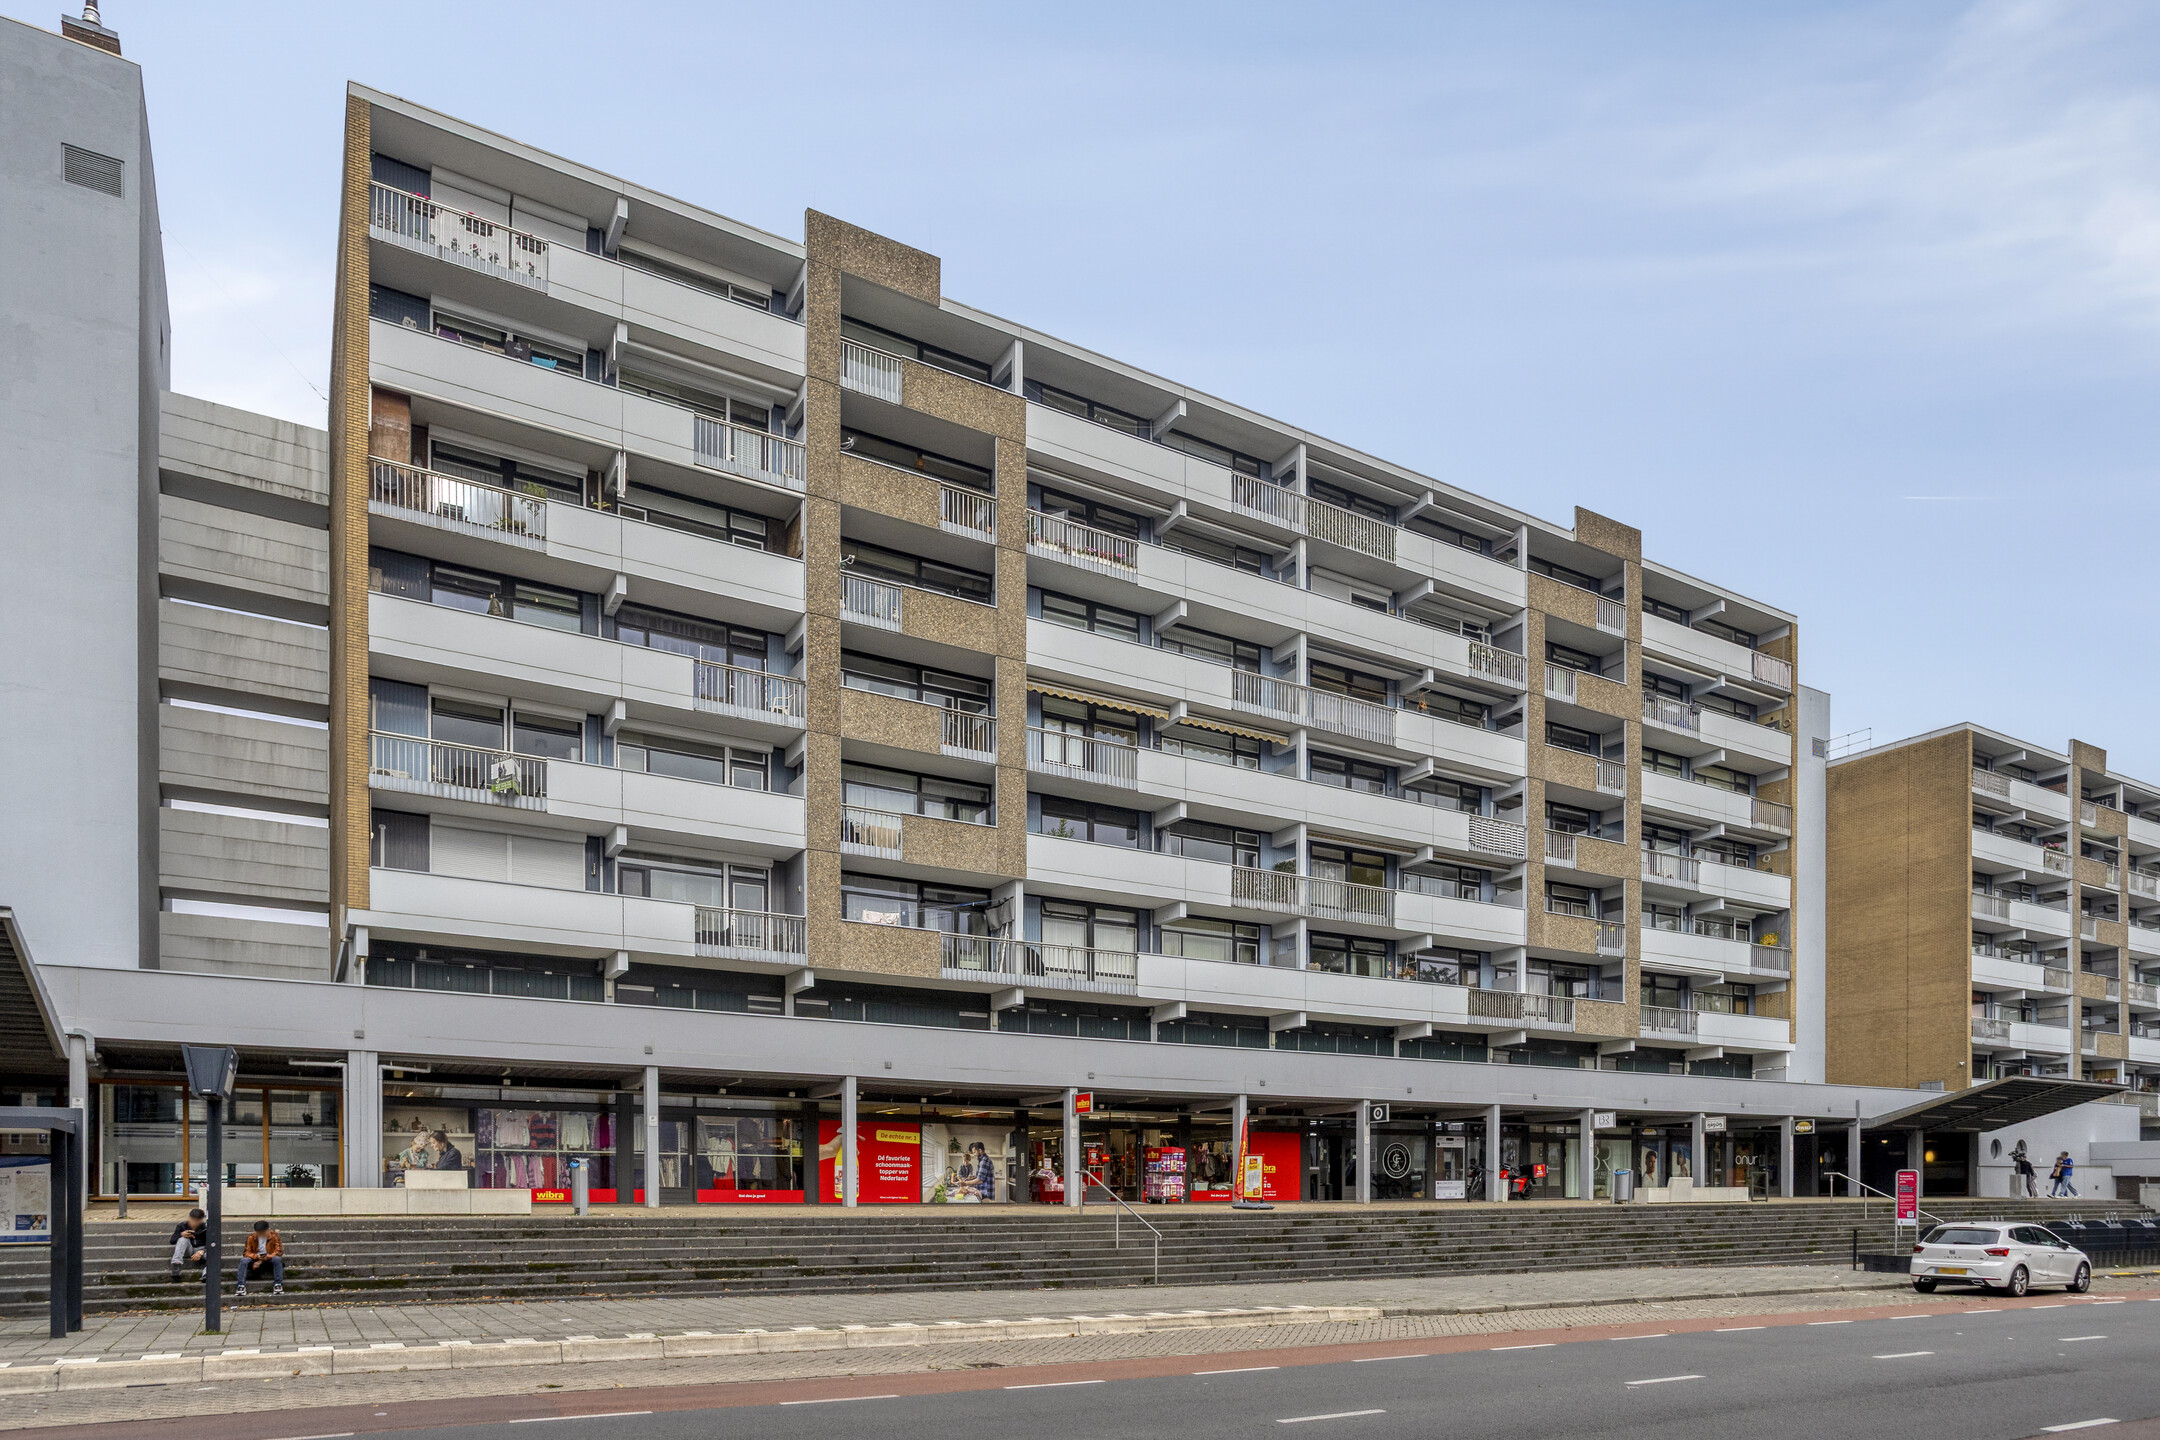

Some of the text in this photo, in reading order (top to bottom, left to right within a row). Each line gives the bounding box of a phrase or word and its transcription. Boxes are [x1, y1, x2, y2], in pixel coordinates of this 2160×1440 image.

[1076, 1099, 1090, 1108] wibra
[1735, 1155, 1758, 1165] onur
[1264, 1163, 1276, 1171] bra
[536, 1190, 564, 1200] wibra
